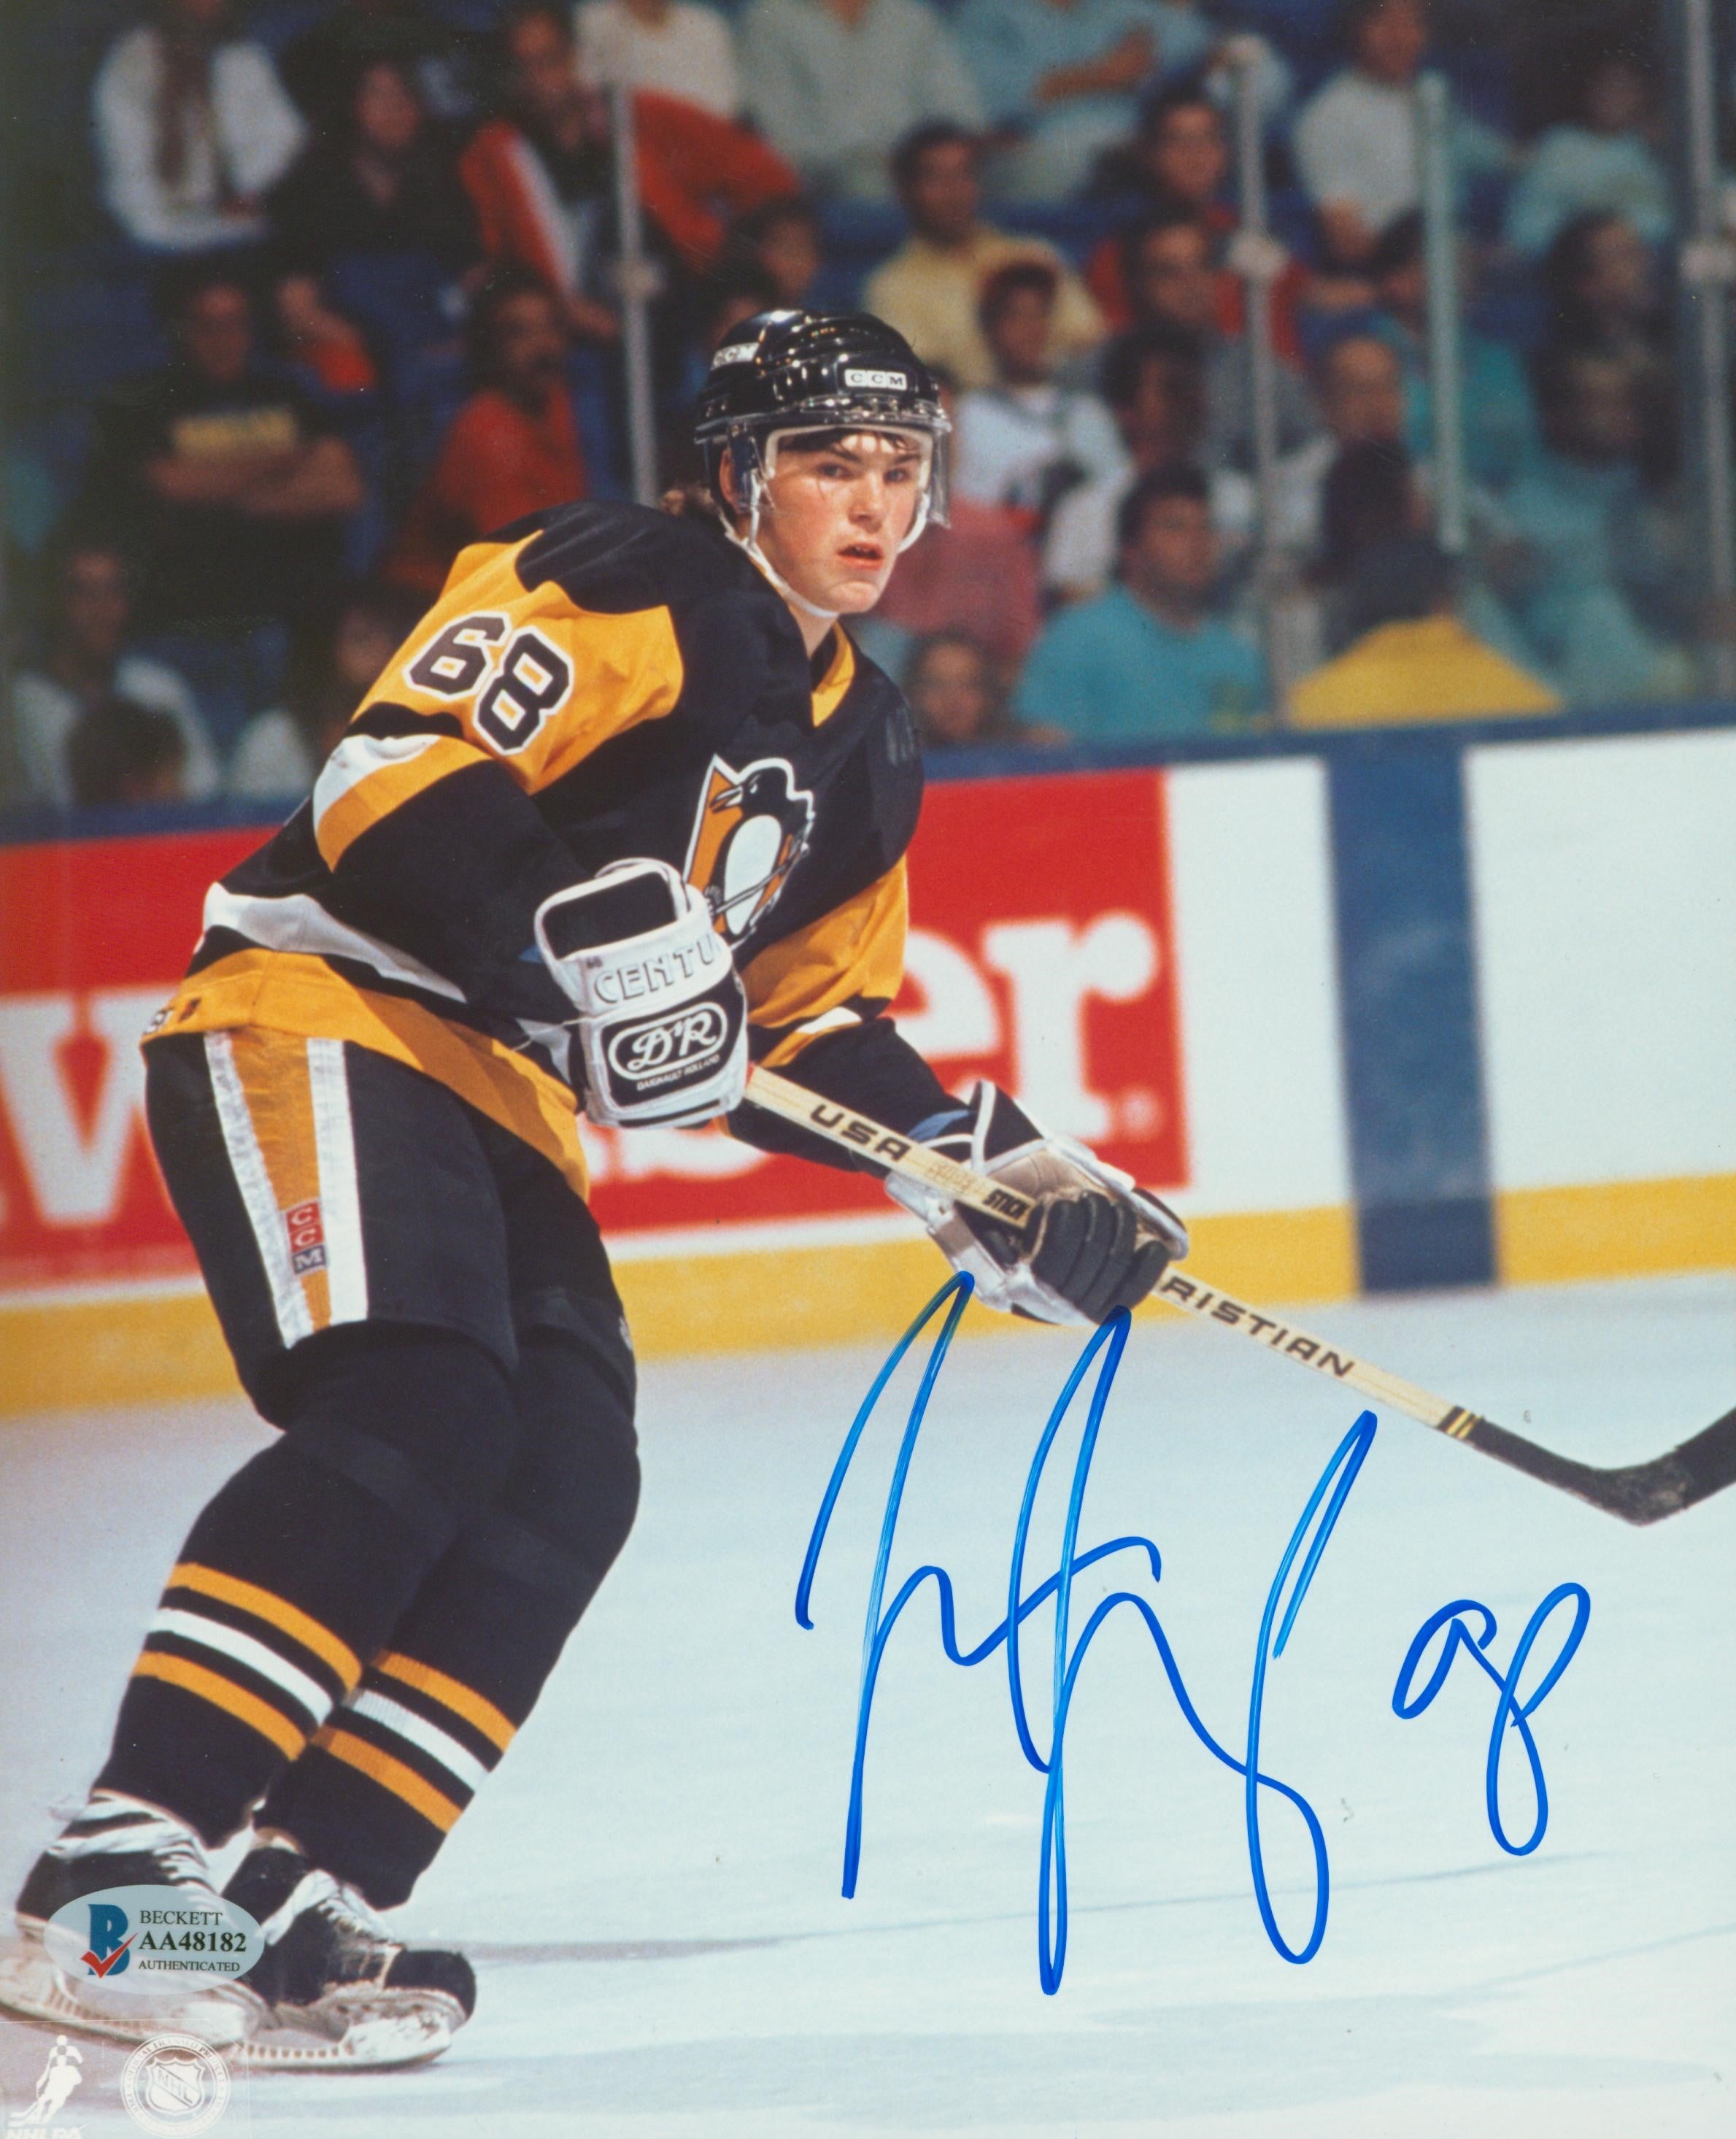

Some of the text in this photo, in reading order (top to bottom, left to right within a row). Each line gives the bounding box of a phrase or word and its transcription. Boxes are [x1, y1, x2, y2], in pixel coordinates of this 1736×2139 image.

[850, 371, 905, 387] CCM
[403, 611, 574, 755] 68
[594, 933, 721, 1003] CENTU
[809, 1103, 911, 1162] USA
[290, 1206, 323, 1271] CCM
[1160, 1274, 1355, 1378] RISTIAN
